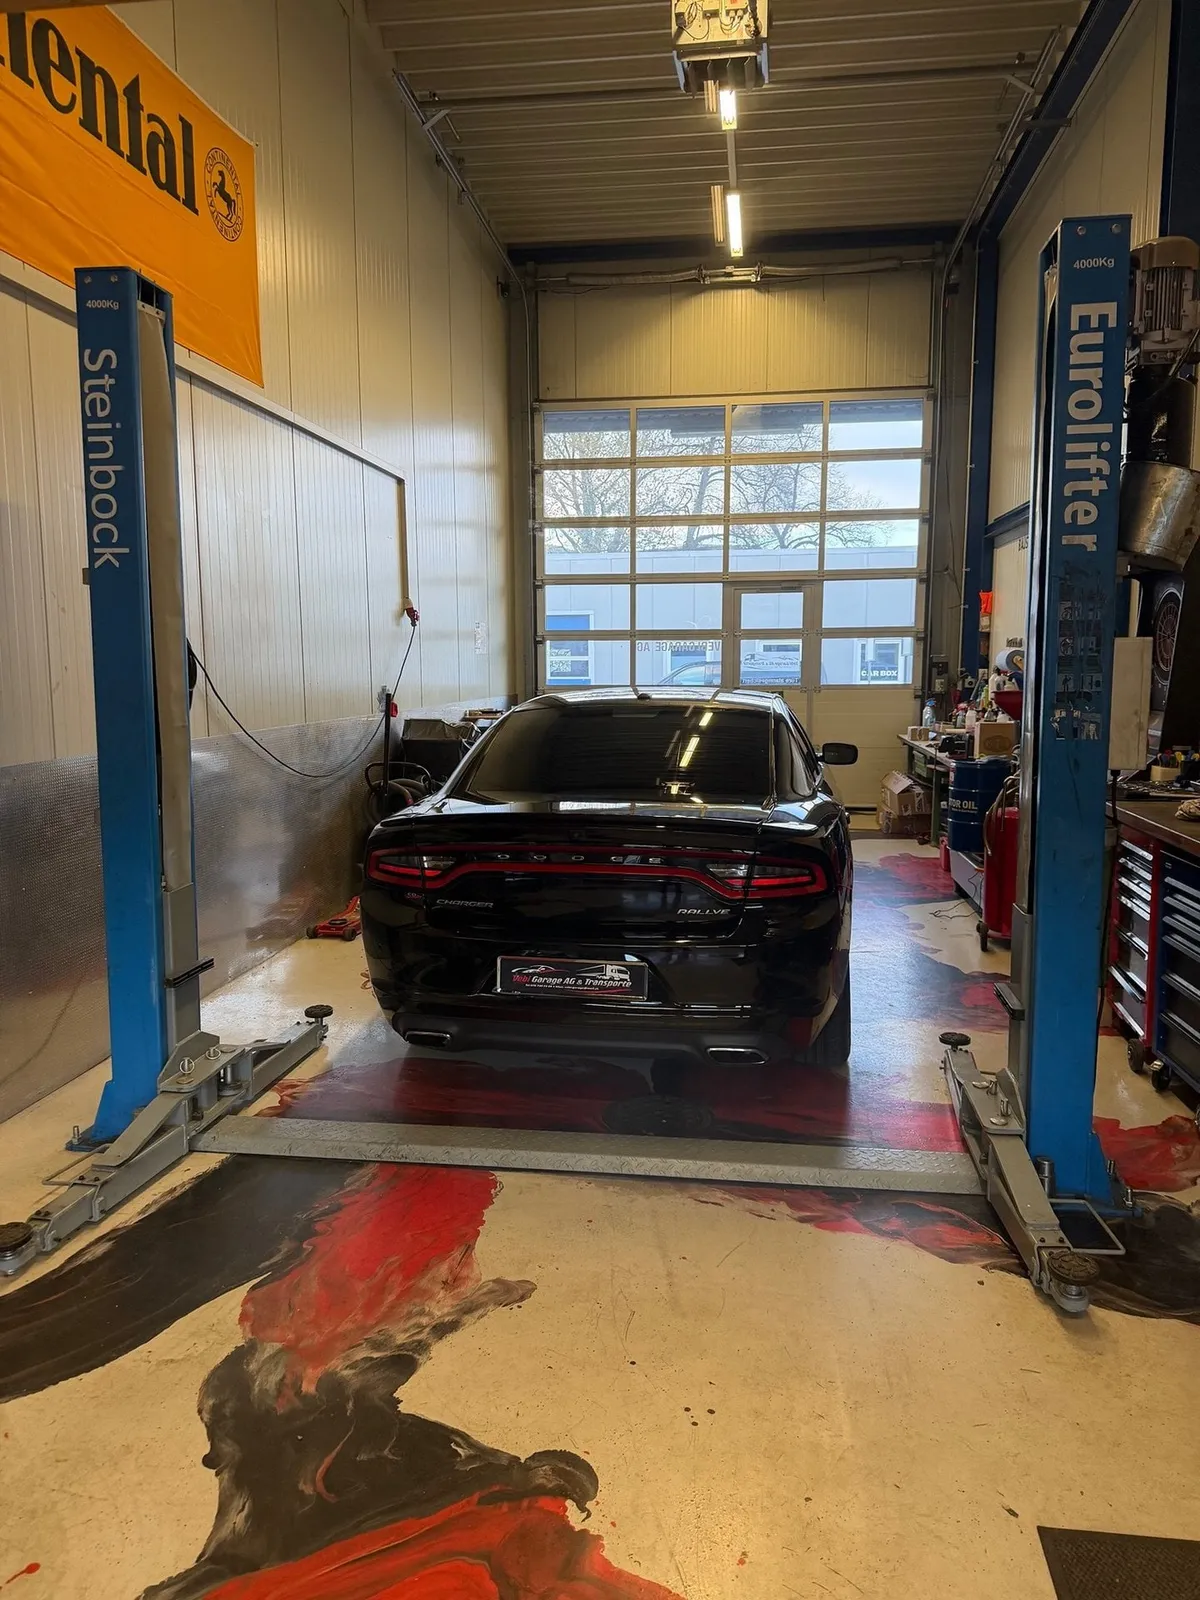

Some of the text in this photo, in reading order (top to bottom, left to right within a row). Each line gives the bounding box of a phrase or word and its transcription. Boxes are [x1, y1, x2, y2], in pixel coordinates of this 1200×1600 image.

[1073, 257, 1115, 269] 4000Kg
[86, 299, 119, 310] 4000Kg
[1062, 302, 1117, 552] Eurolifter
[83, 348, 130, 568] Steinbock
[962, 801, 978, 810] OIL
[436, 899, 494, 908] CHARGER
[531, 976, 563, 985] Garage
[563, 977, 576, 985] AG
[584, 978, 632, 988] Transporte
